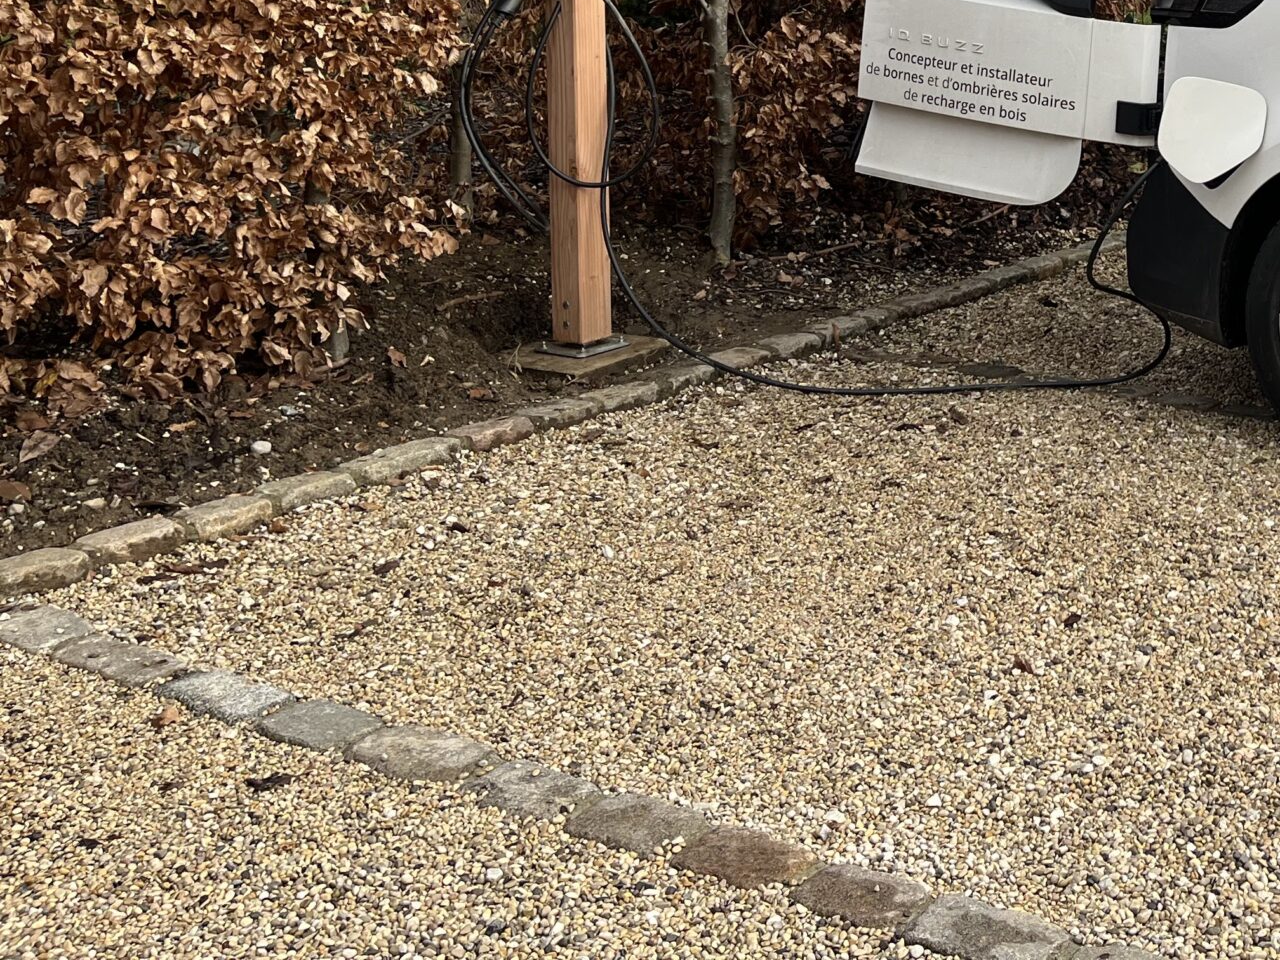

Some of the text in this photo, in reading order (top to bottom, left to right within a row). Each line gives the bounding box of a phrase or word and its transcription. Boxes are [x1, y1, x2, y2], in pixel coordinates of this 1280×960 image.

[921, 33, 984, 54] BUZZ
[888, 47, 1053, 87] Concepteur et installateur
[866, 62, 1076, 111] de bornes et d'ombrières solaires
[903, 88, 1027, 122] de recharge en bois
